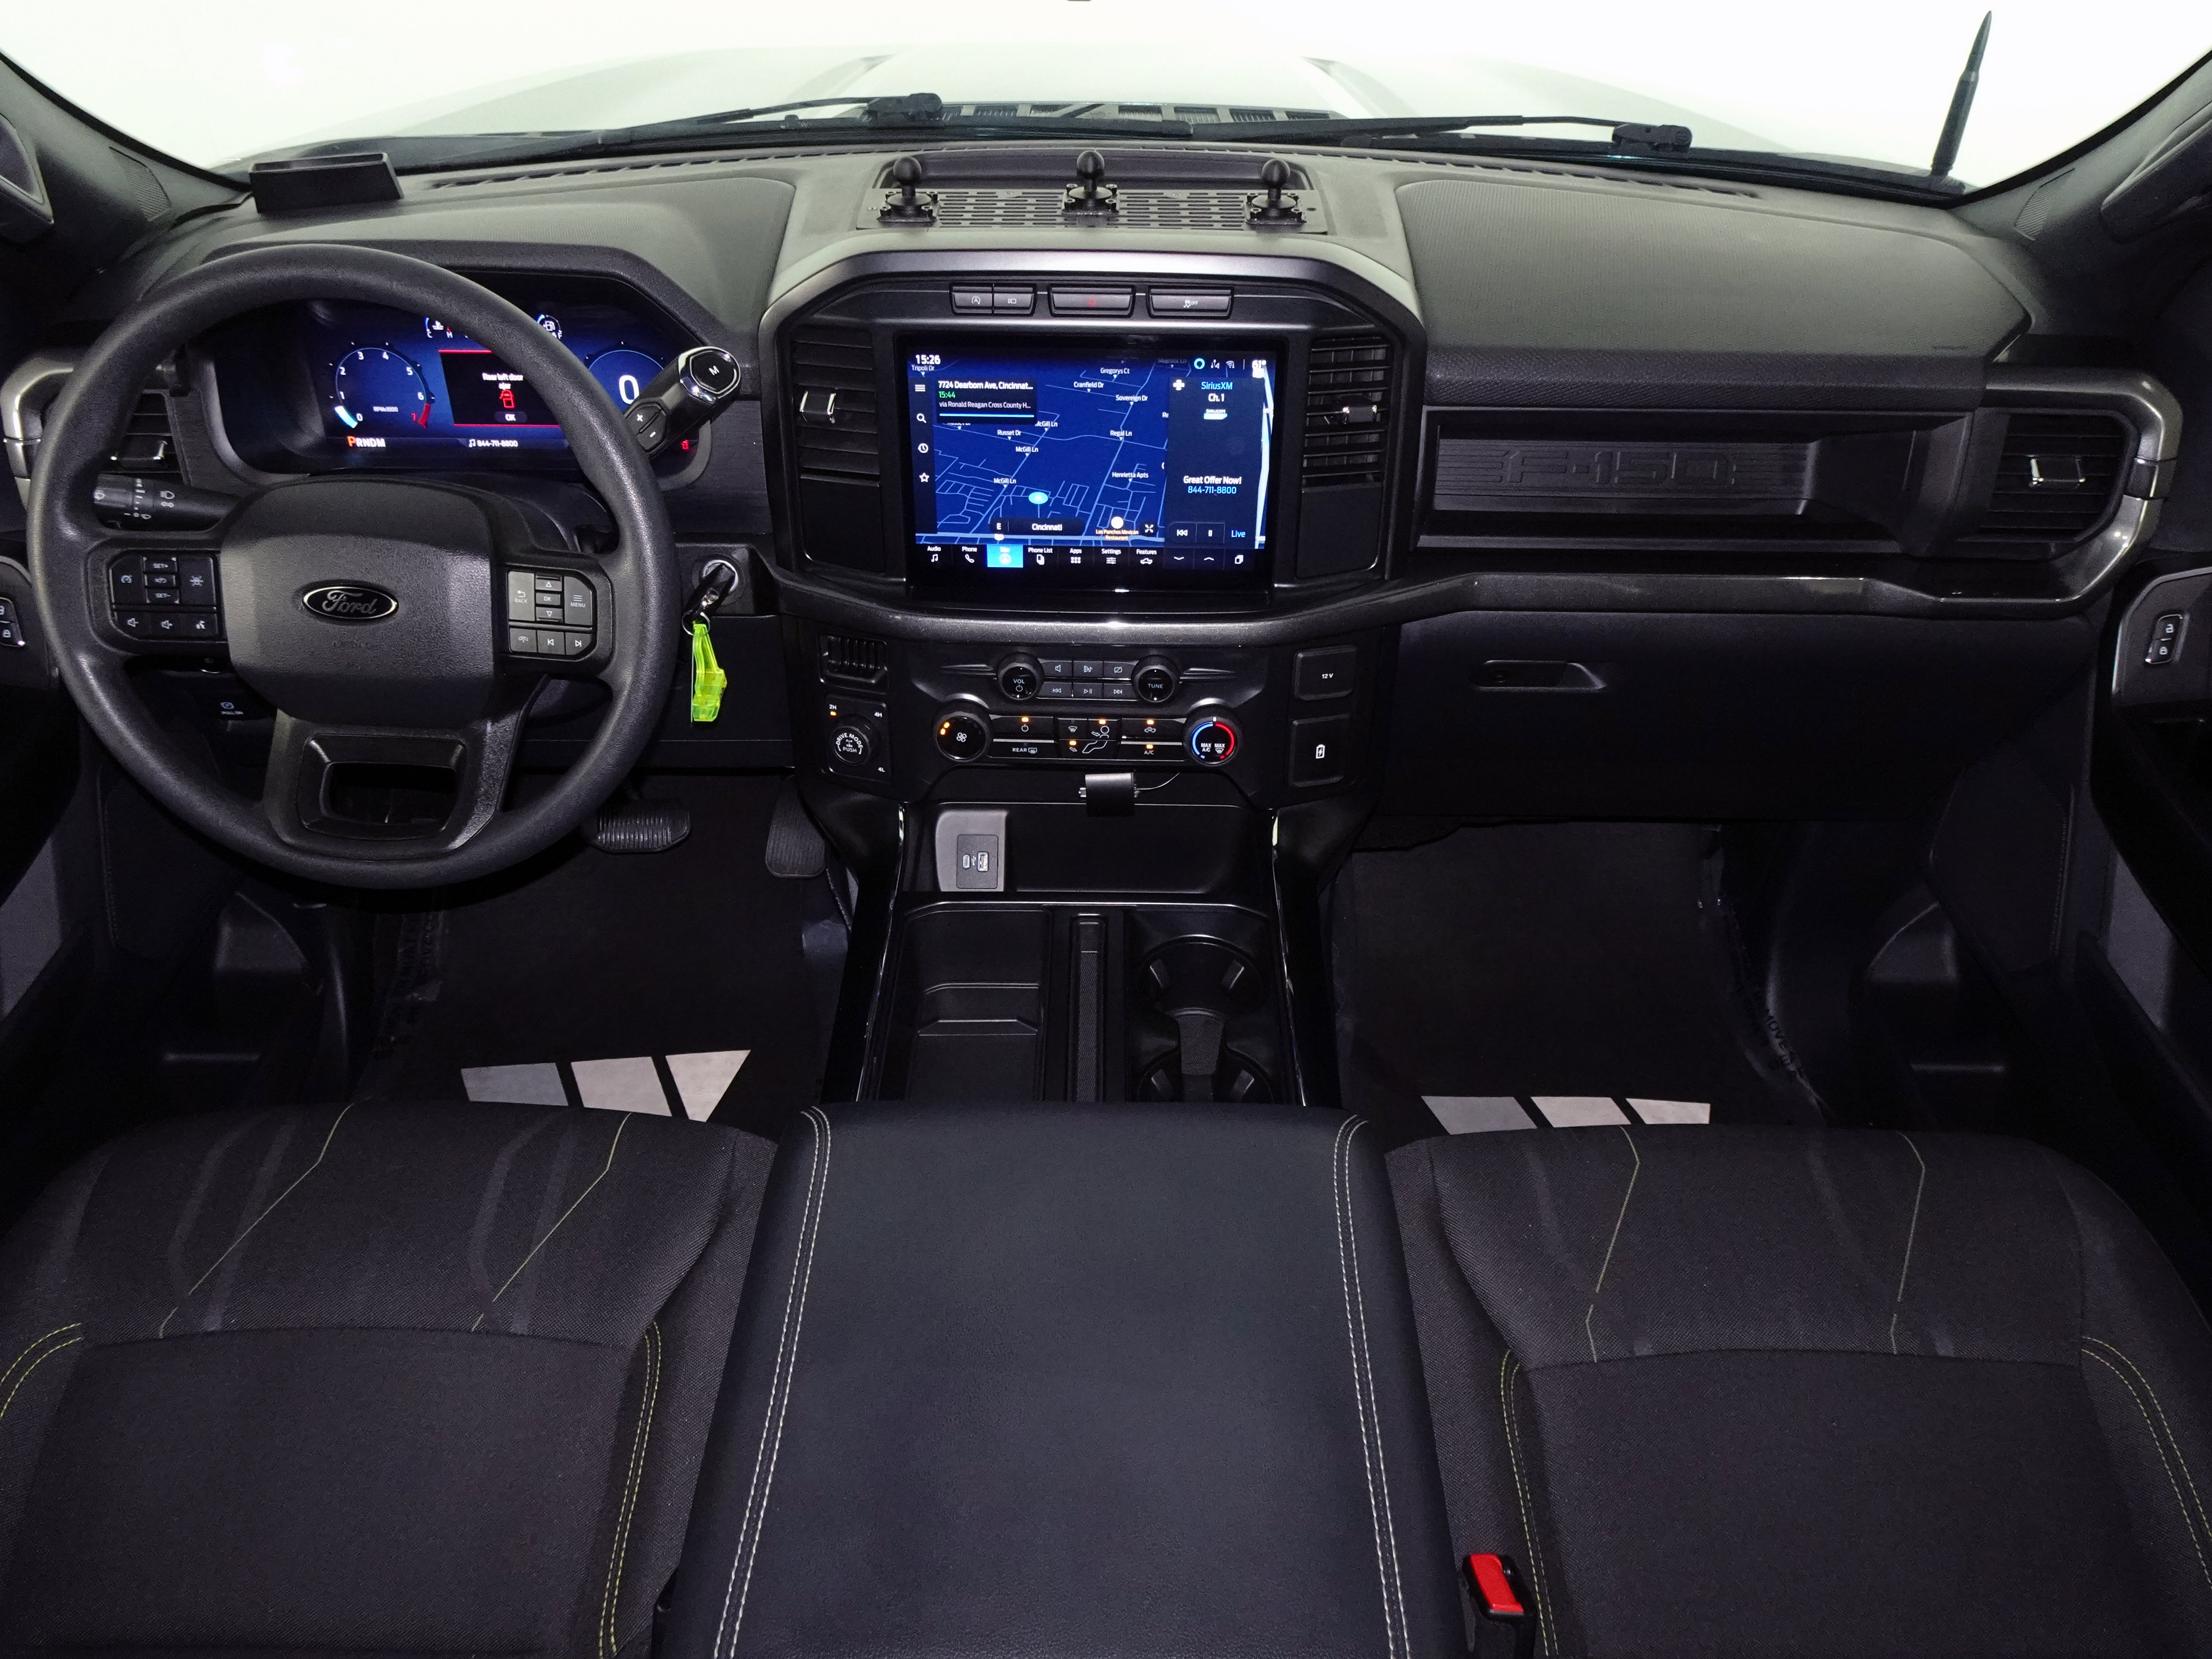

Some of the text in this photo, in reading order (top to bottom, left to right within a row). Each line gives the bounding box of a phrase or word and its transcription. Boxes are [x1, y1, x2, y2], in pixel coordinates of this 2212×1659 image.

[357, 351, 364, 360] 3
[383, 351, 389, 360] 4
[915, 355, 941, 365] 15:26
[340, 367, 346, 375] 2
[407, 367, 413, 375] 5
[708, 365, 720, 375] M
[619, 375, 639, 404] 0
[340, 391, 345, 399] 1
[417, 392, 424, 400] 6
[356, 413, 363, 421] 0
[1183, 476, 1242, 484] Great Offer Now!
[1188, 486, 1237, 494] 844-711-8800
[322, 590, 377, 615] Ford
[836, 732, 863, 749] DRIVE MODE
